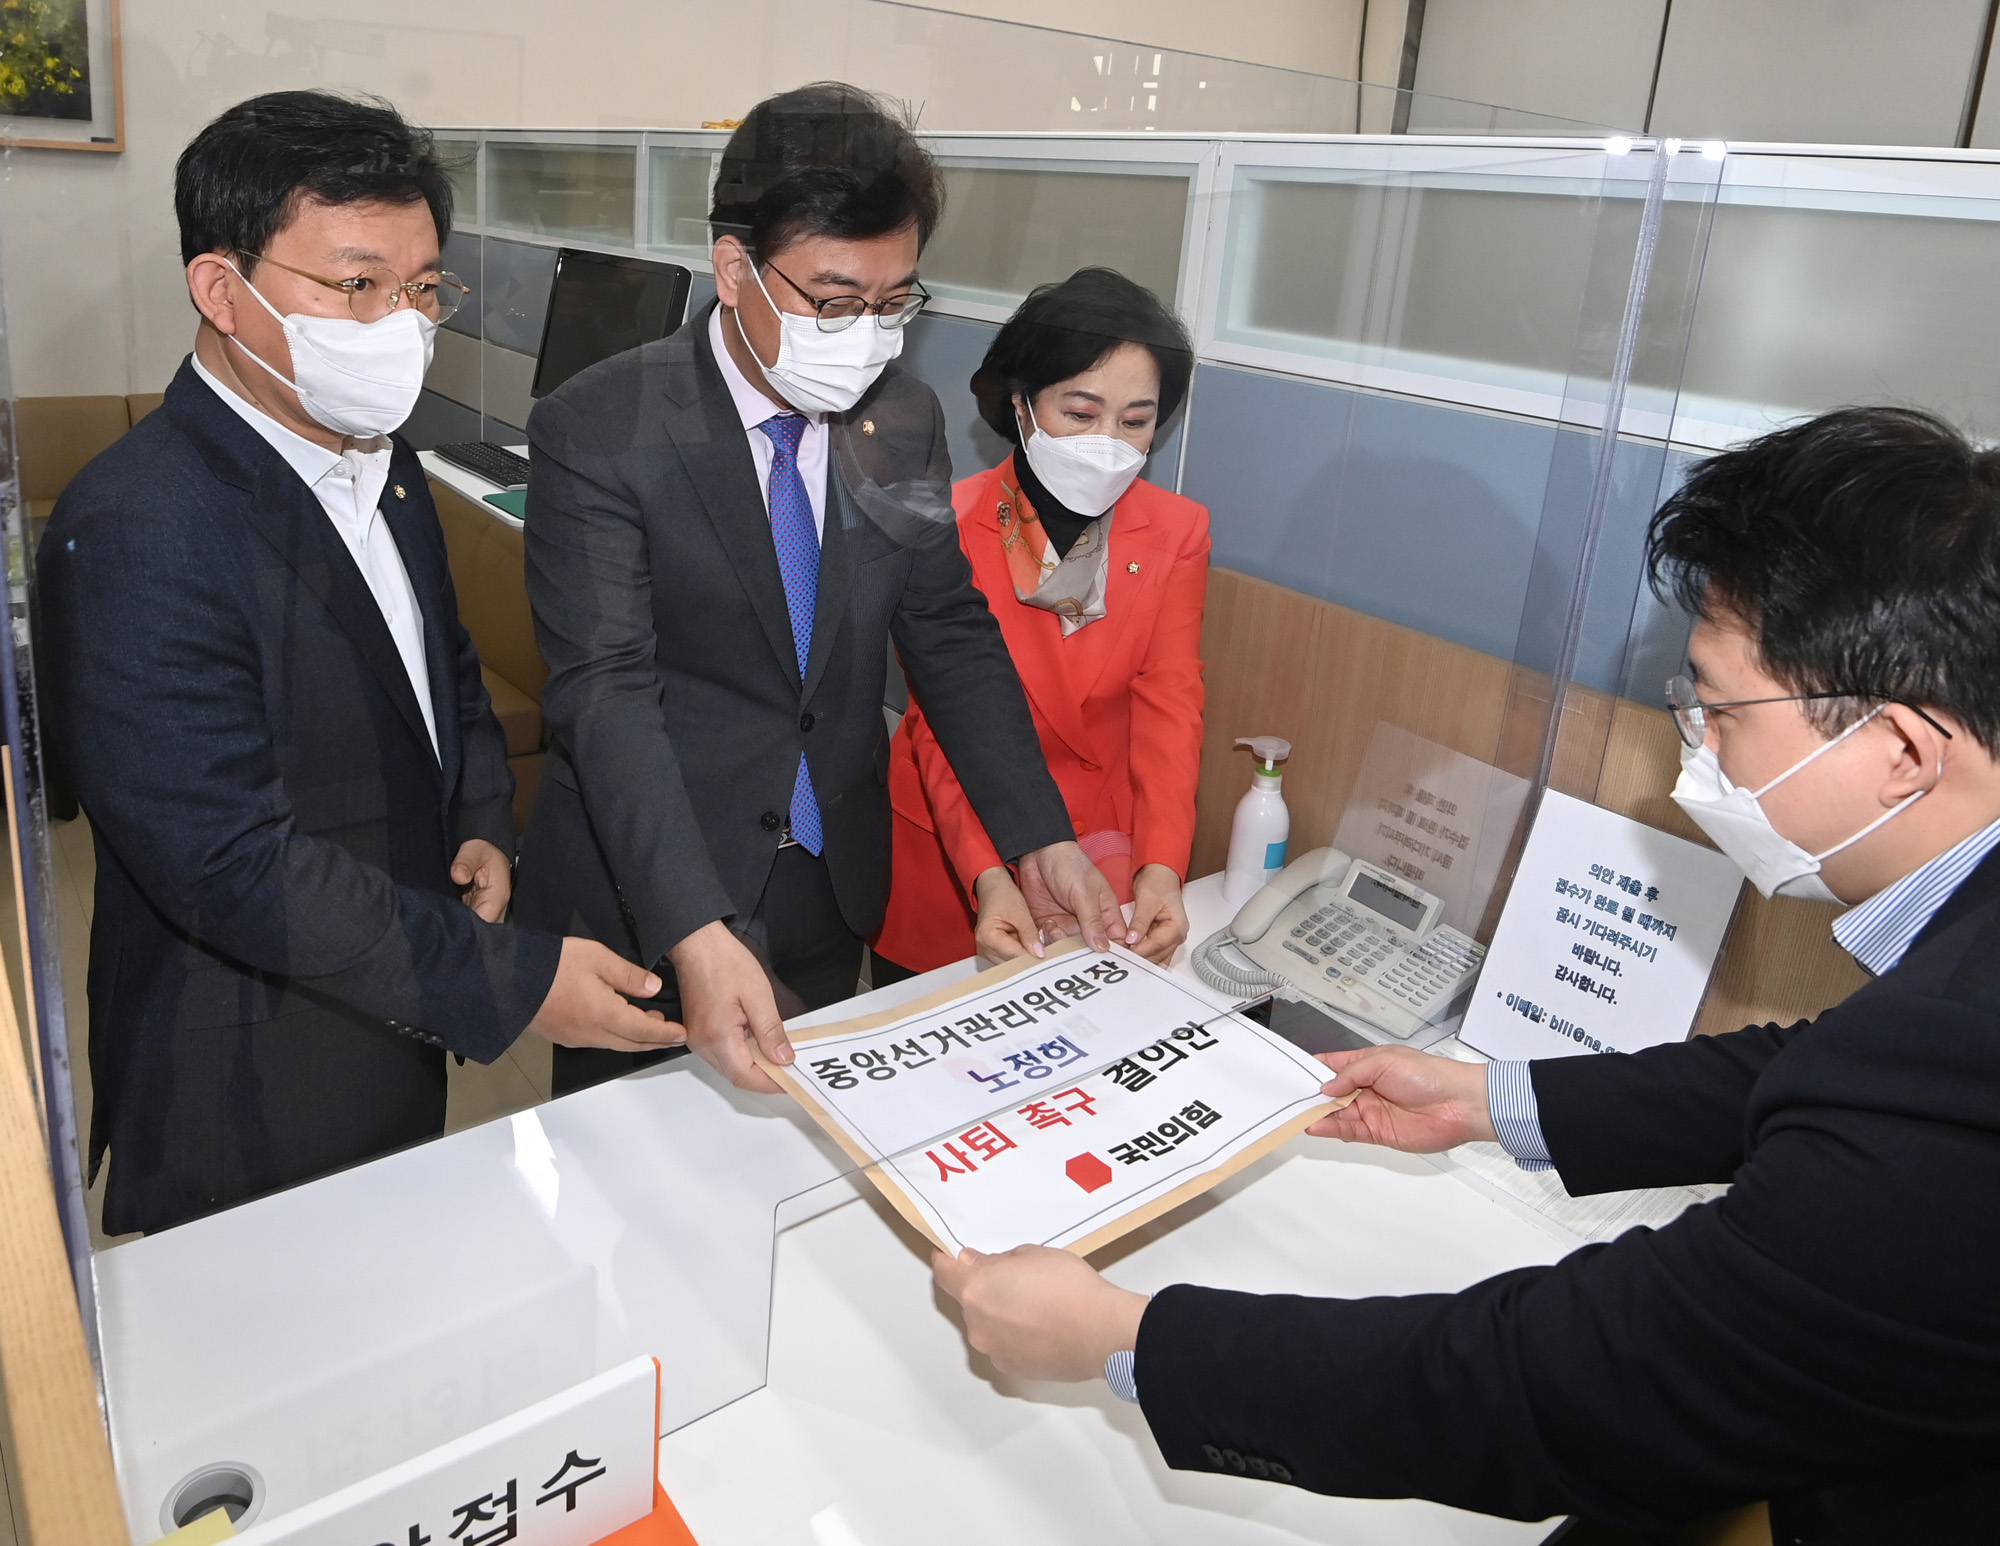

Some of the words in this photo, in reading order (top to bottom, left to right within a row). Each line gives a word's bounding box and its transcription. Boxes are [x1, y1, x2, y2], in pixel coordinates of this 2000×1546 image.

[1555, 877, 1592, 905] 접수가
[1593, 894, 1620, 916] 완료
[1621, 905, 1636, 924] 될
[1637, 912, 1678, 941] 때까지
[1588, 863, 1615, 885] 의안
[1616, 874, 1643, 897] 제출
[1644, 886, 1660, 902] 후
[1555, 906, 1582, 929] 잠시
[1582, 918, 1658, 963] 기다려주시기
[1571, 942, 1623, 978] 바랍니다.
[1554, 964, 1618, 1005] 감사합니다.
[809, 959, 1131, 1090] 중앙선거관리위원장
[1505, 993, 1548, 1024] 이메일:
[1549, 1014, 1622, 1054] bill@na.
[966, 1034, 1089, 1094] 노정희
[924, 1120, 1018, 1183] 사퇴
[1016, 1086, 1098, 1133] 촉구
[1101, 1020, 1222, 1094] 결의안
[1106, 1098, 1224, 1167] 국민의힘
